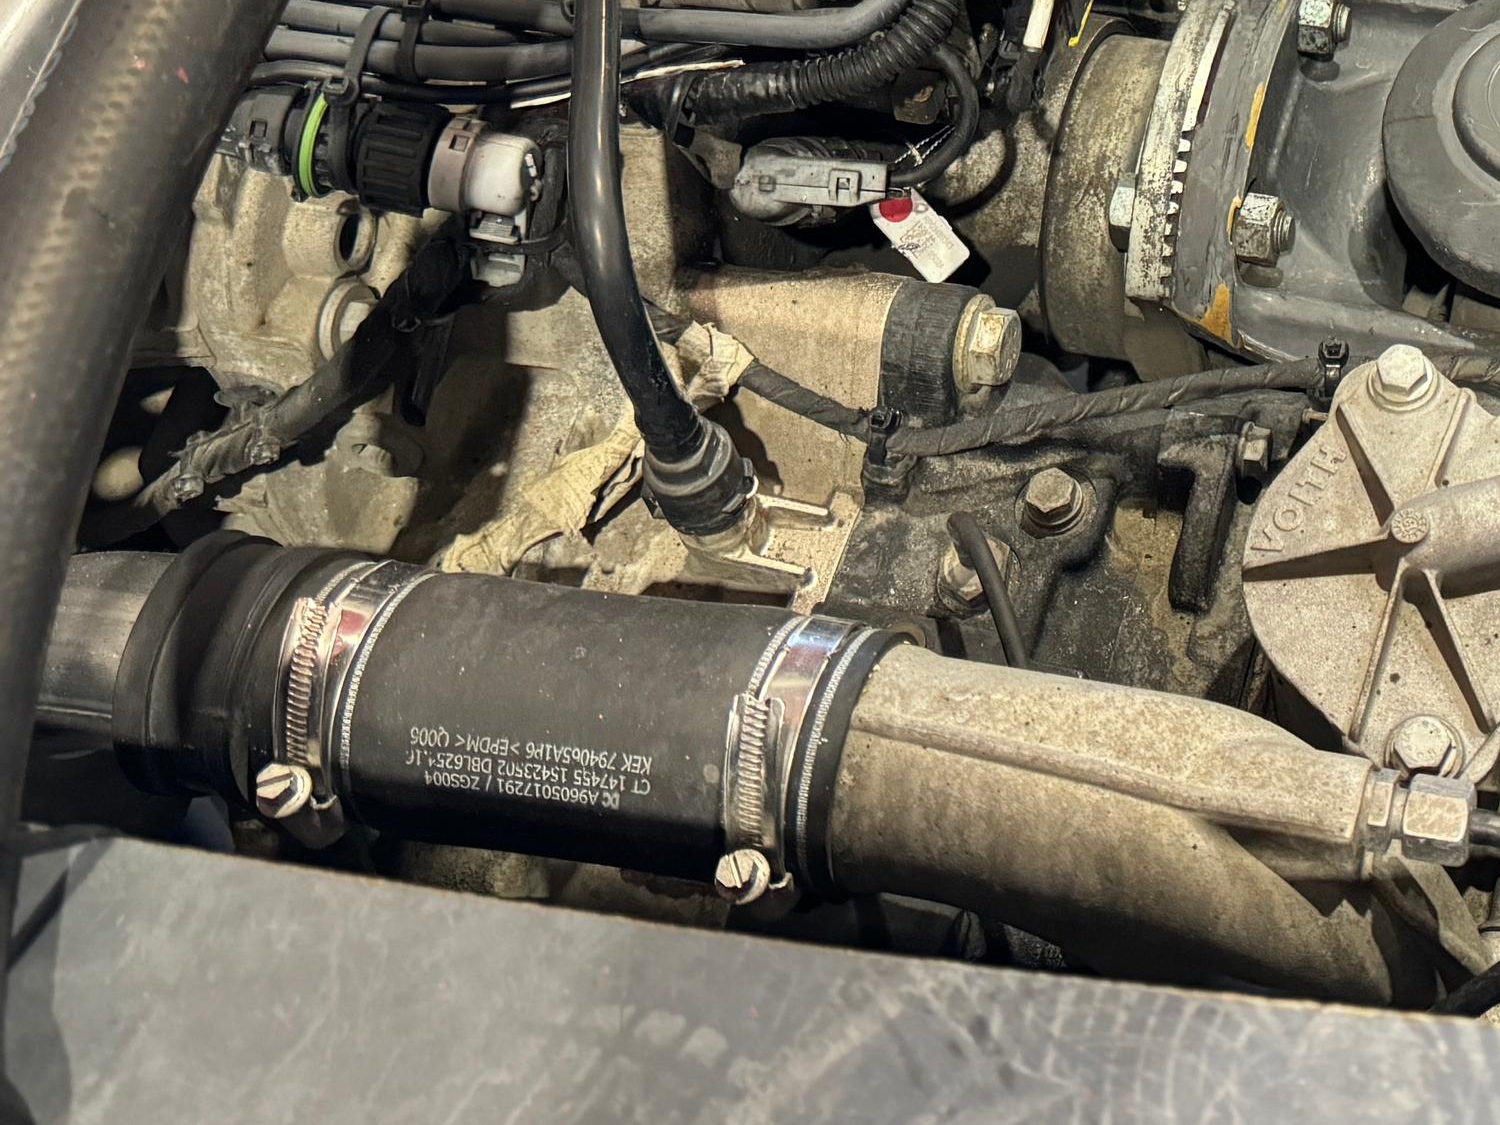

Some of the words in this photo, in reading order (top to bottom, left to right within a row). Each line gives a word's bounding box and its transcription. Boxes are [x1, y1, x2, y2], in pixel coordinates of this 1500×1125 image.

[1250, 443, 1348, 553] VOITH
[621, 752, 652, 776] KEK
[424, 770, 480, 790] ZGS004
[574, 769, 626, 792] 147455
[630, 778, 651, 796] CT
[497, 778, 599, 806] A9605017291
[602, 792, 620, 810] DC
